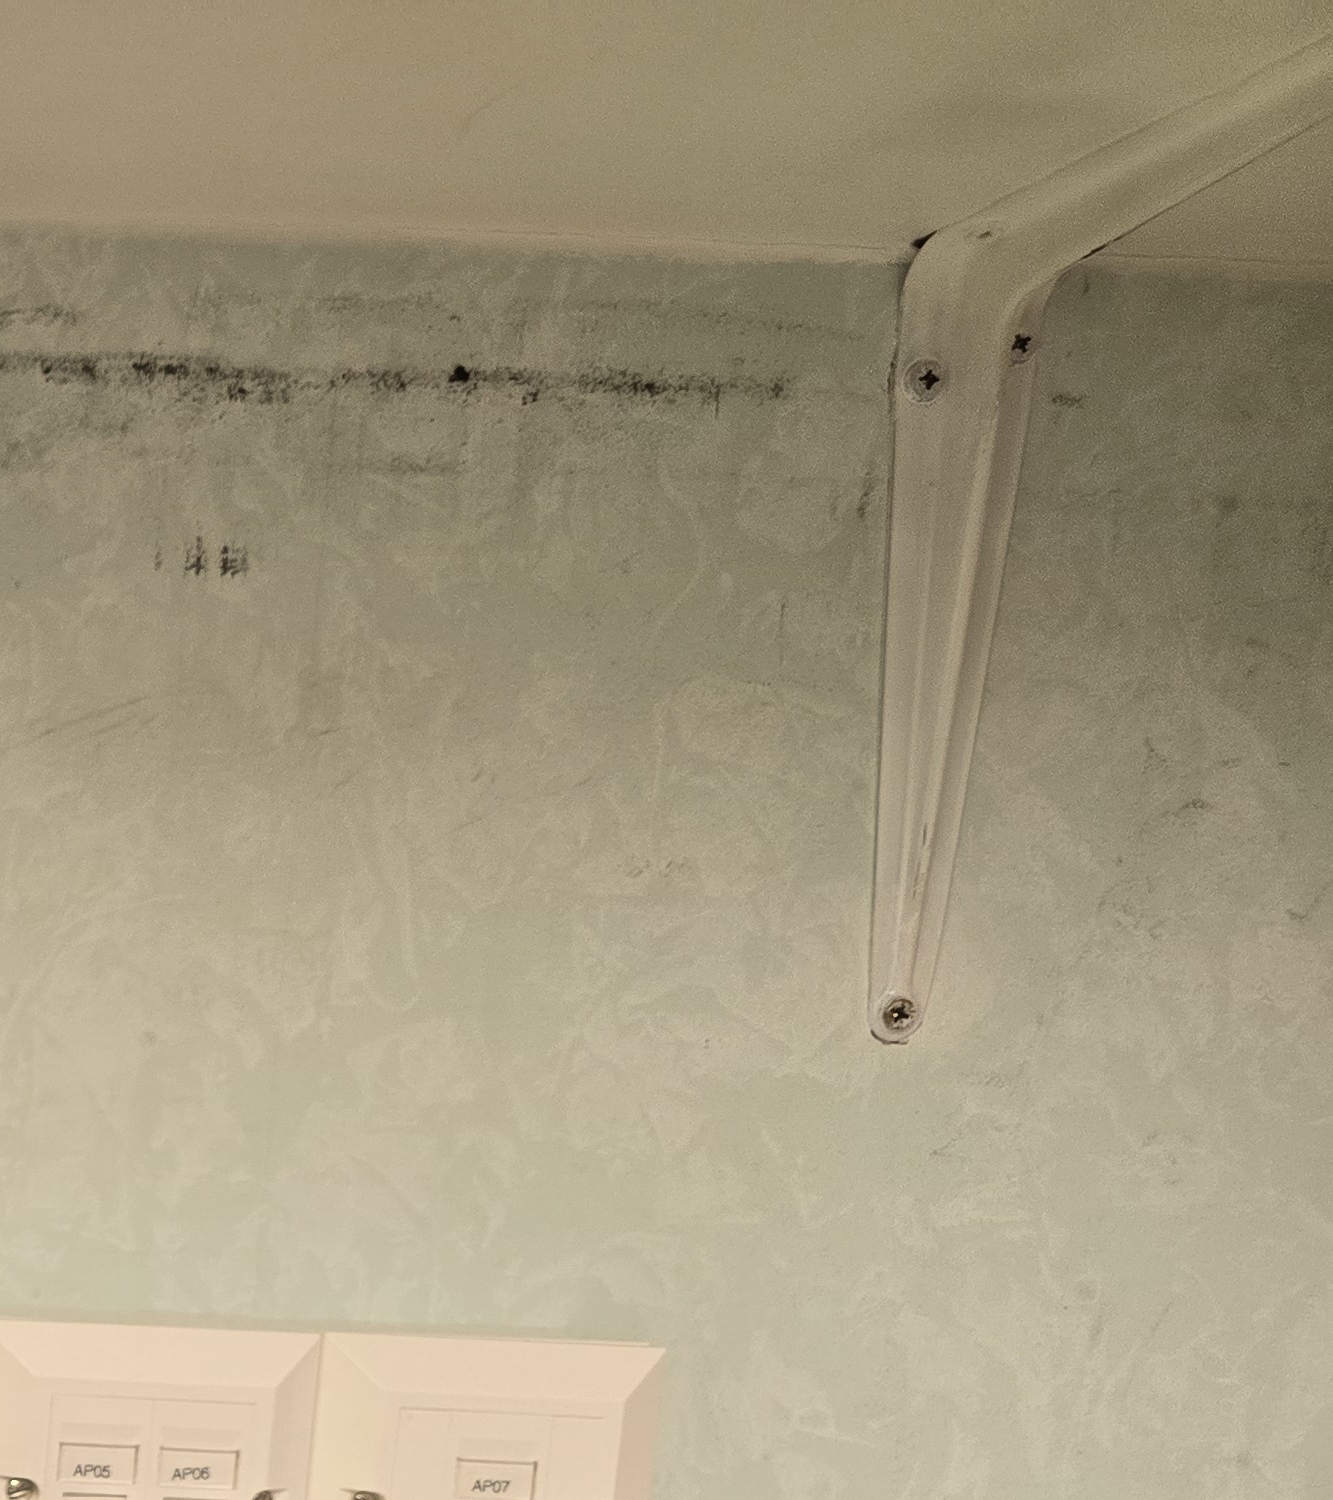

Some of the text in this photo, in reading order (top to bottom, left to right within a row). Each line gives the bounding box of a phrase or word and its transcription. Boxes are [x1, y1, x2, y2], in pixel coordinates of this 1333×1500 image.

[72, 1463, 111, 1480] AP05
[171, 1466, 211, 1481] AP06
[470, 1479, 511, 1494] AP07
